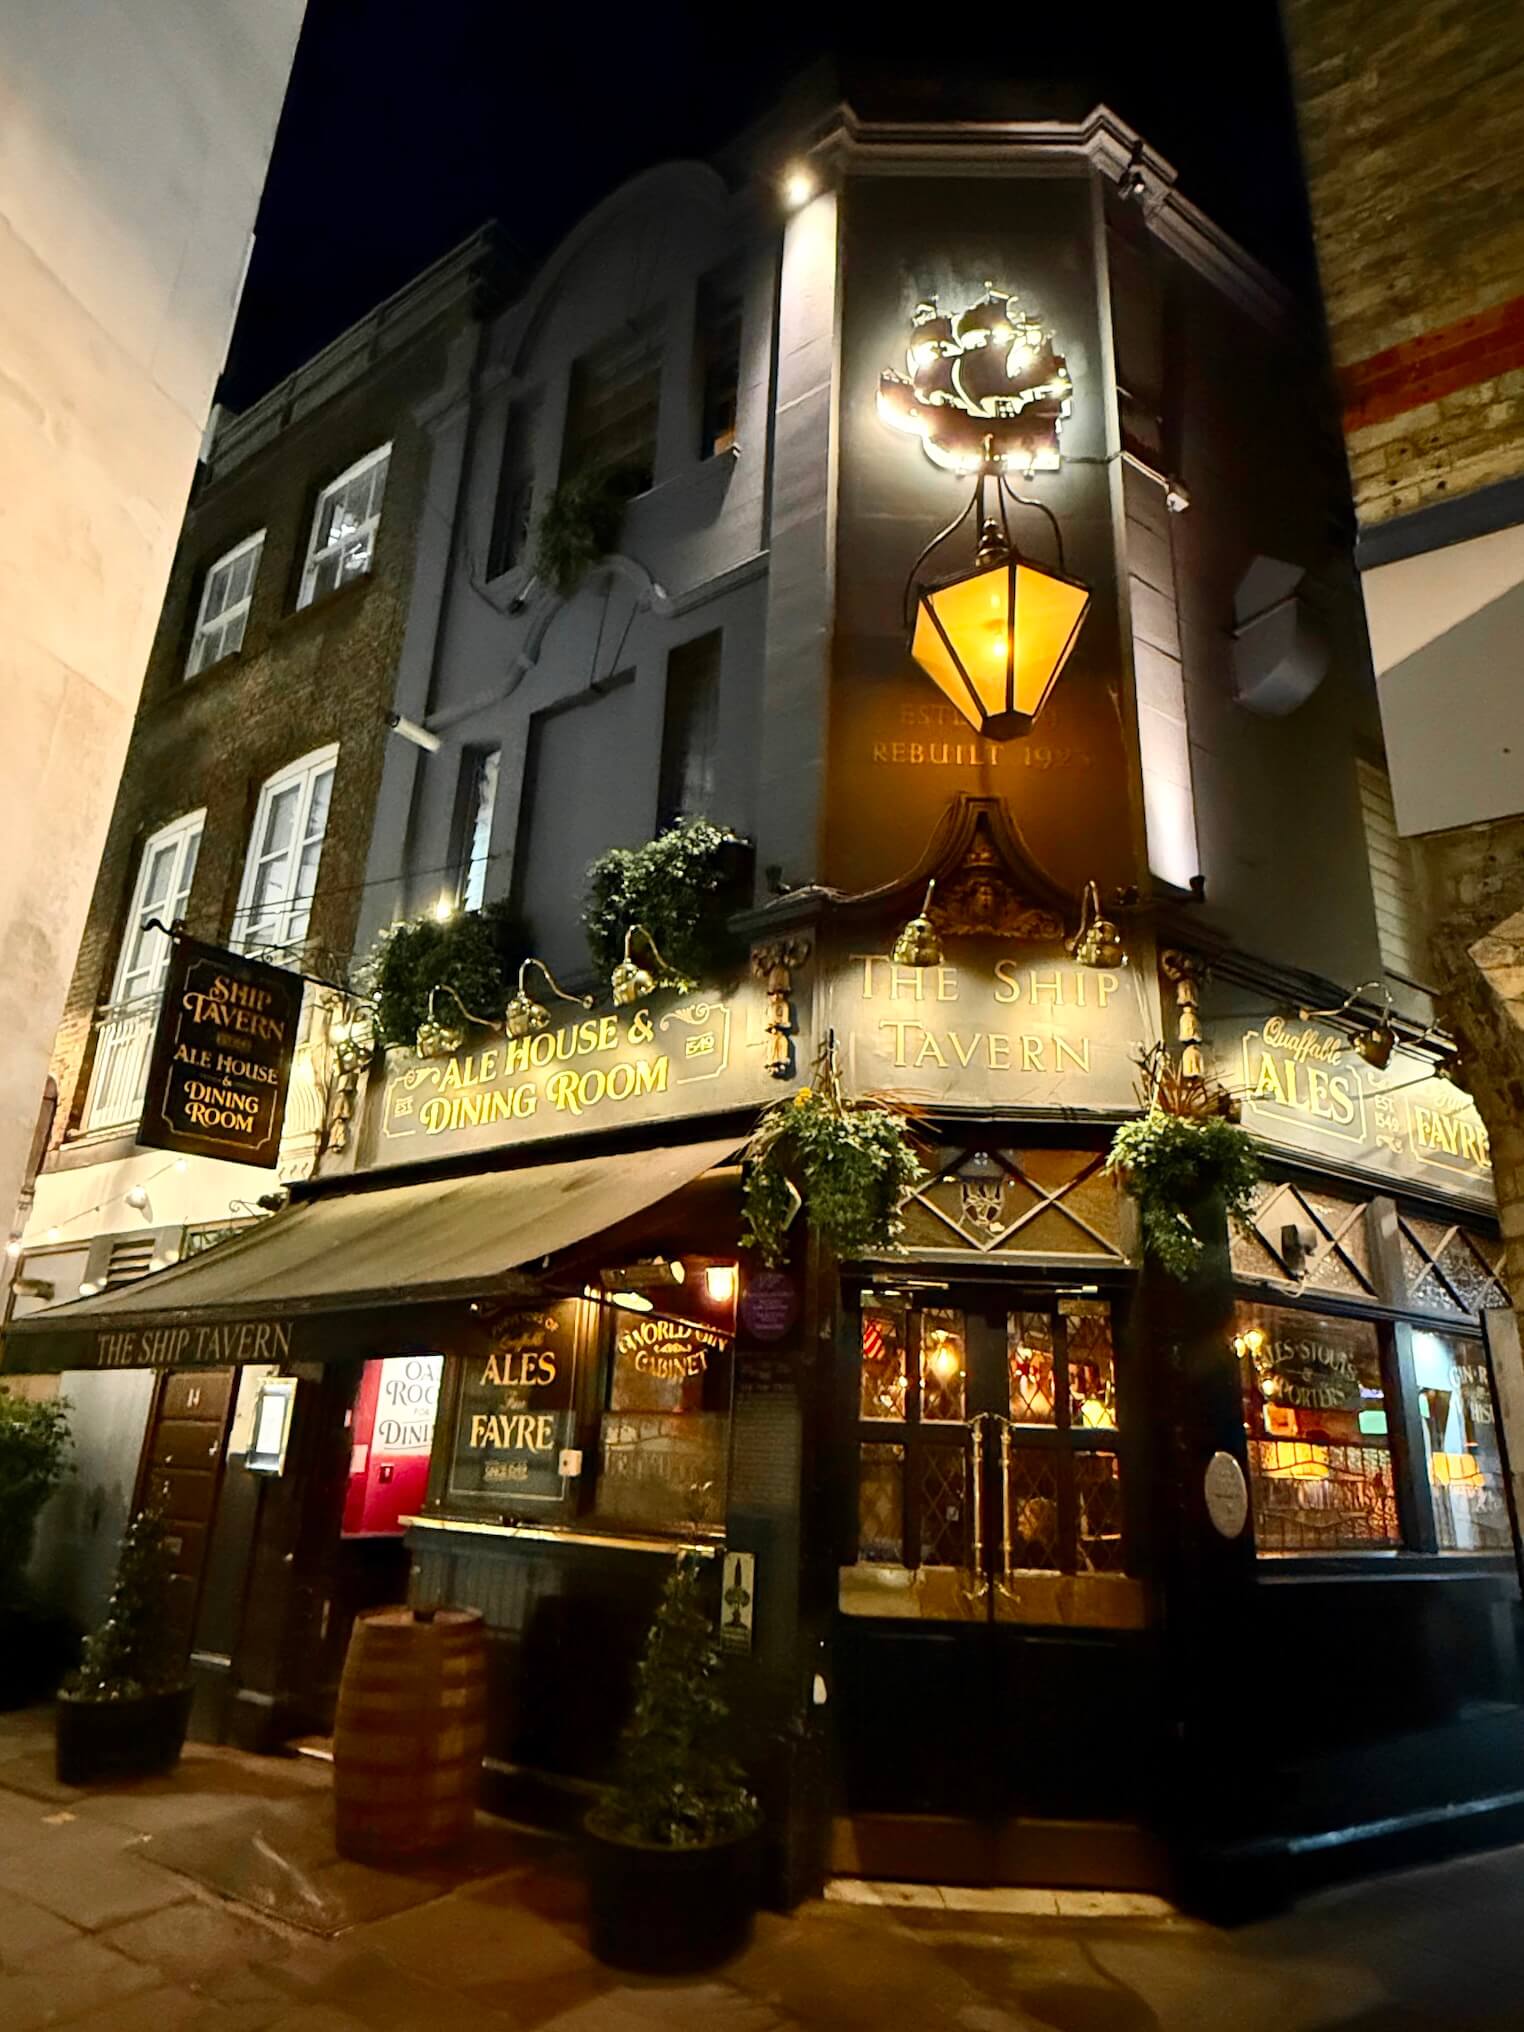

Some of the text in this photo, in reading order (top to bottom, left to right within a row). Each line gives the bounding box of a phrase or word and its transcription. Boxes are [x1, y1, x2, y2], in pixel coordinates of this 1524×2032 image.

[872, 743, 1004, 766] REBUILT
[209, 976, 272, 1012] SHIP
[850, 954, 1119, 1008] THE SHIP
[183, 991, 286, 1041] TAVERN
[438, 1009, 655, 1094] ALE HOUSE &
[879, 1019, 1090, 1073] TAVERN
[1262, 1016, 1343, 1066] Quaffable
[173, 1043, 279, 1085] ALE HOUSE
[221, 1077, 232, 1087] &
[184, 1080, 259, 1113] DINING
[419, 1055, 669, 1136] DINING ROOM
[1255, 1051, 1354, 1125] ALES
[184, 1101, 254, 1133] ROOM
[97, 1321, 294, 1366] THE SHIP TAVERN
[617, 1321, 692, 1354] WORLD
[405, 1361, 438, 1381] OA
[480, 1352, 556, 1386] ALES
[635, 1349, 709, 1378] CABINET
[469, 1414, 555, 1454] FAYRE
